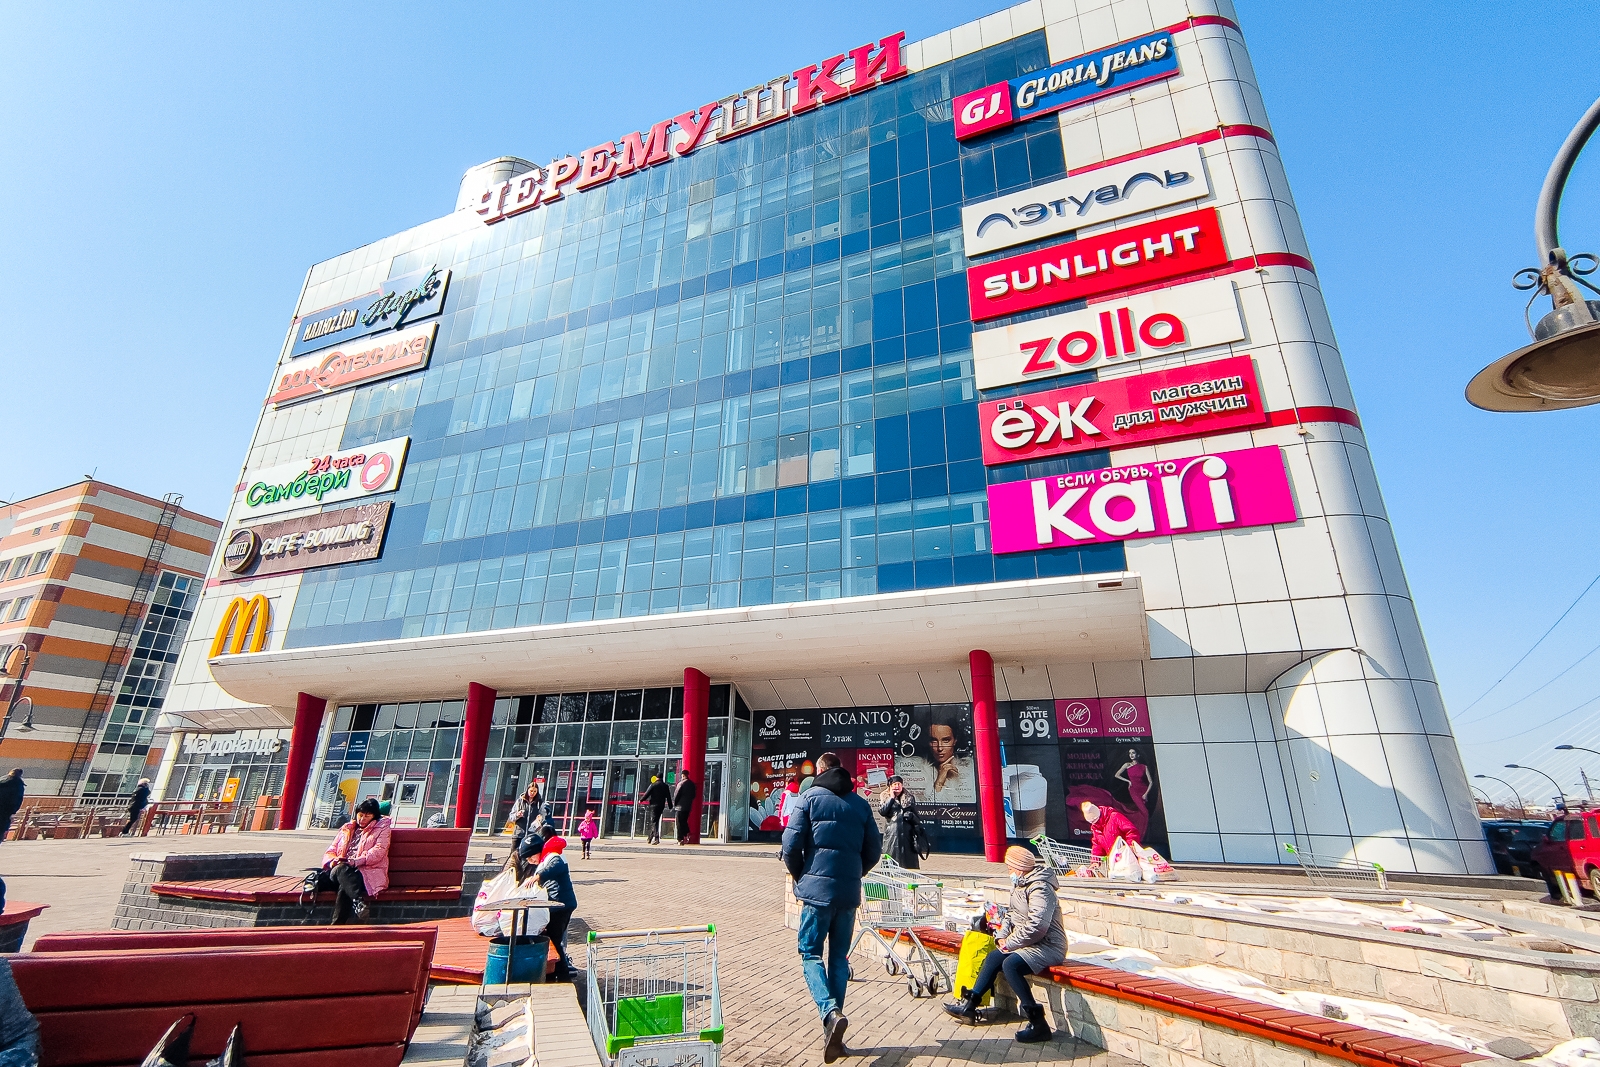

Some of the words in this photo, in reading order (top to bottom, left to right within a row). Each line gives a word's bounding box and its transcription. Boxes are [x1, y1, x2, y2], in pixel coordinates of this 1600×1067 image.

[1016, 60, 1097, 109] GLORIA
[1095, 38, 1169, 86] JEANS
[474, 30, 908, 225] ЧЕРЕМУШКИ
[983, 226, 1201, 299] SUNLIGHT
[1020, 307, 1186, 375] zolla
[1151, 375, 1243, 403] магазин
[990, 396, 1103, 450] ёж
[1113, 411, 1154, 431] для
[1160, 393, 1248, 422] мужчин
[308, 455, 331, 475] 24
[332, 453, 366, 468] часа
[1057, 473, 1095, 489] ЕСЛИ
[1100, 466, 1153, 483] ОБУВЬ,
[1154, 462, 1177, 475] ТО
[246, 469, 351, 507] Самбери
[1031, 455, 1236, 545] kari
[822, 711, 892, 726] INCANTO
[1019, 710, 1049, 719] ЛАТТЕ
[759, 728, 781, 737] Hunter
[825, 734, 831, 743] 2
[832, 735, 853, 743] этаж
[1062, 727, 1098, 735] модница
[1108, 726, 1146, 734] модница
[771, 760, 793, 770] ЧАС
[858, 753, 892, 761] INCANTO
[1067, 752, 1101, 760] МОДНАЯ
[1069, 772, 1104, 780] ОДЕЖДА
